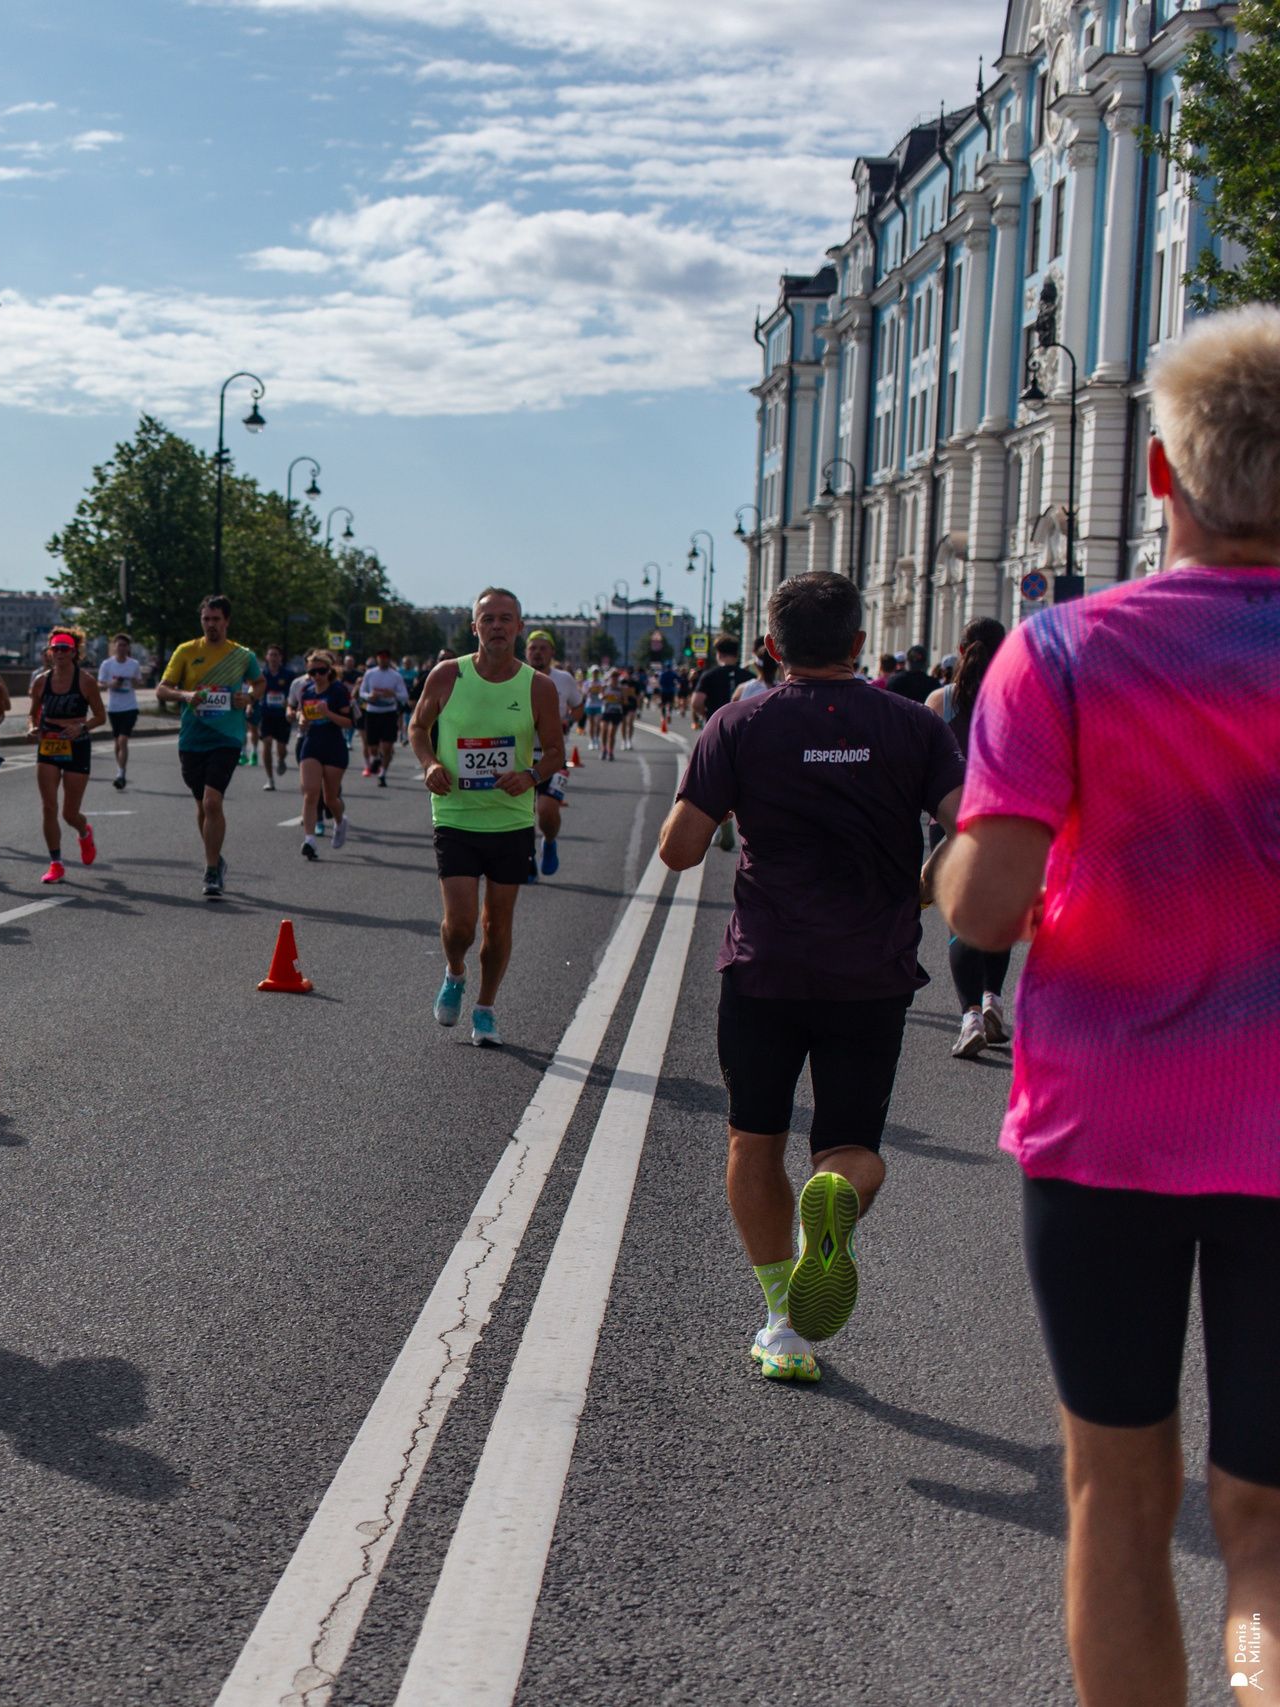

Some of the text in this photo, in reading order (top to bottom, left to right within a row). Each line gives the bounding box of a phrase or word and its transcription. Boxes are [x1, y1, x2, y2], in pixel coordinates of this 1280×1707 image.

[465, 752, 508, 769] 3243
[803, 748, 870, 763] DESPERADOS
[463, 780, 471, 789] D
